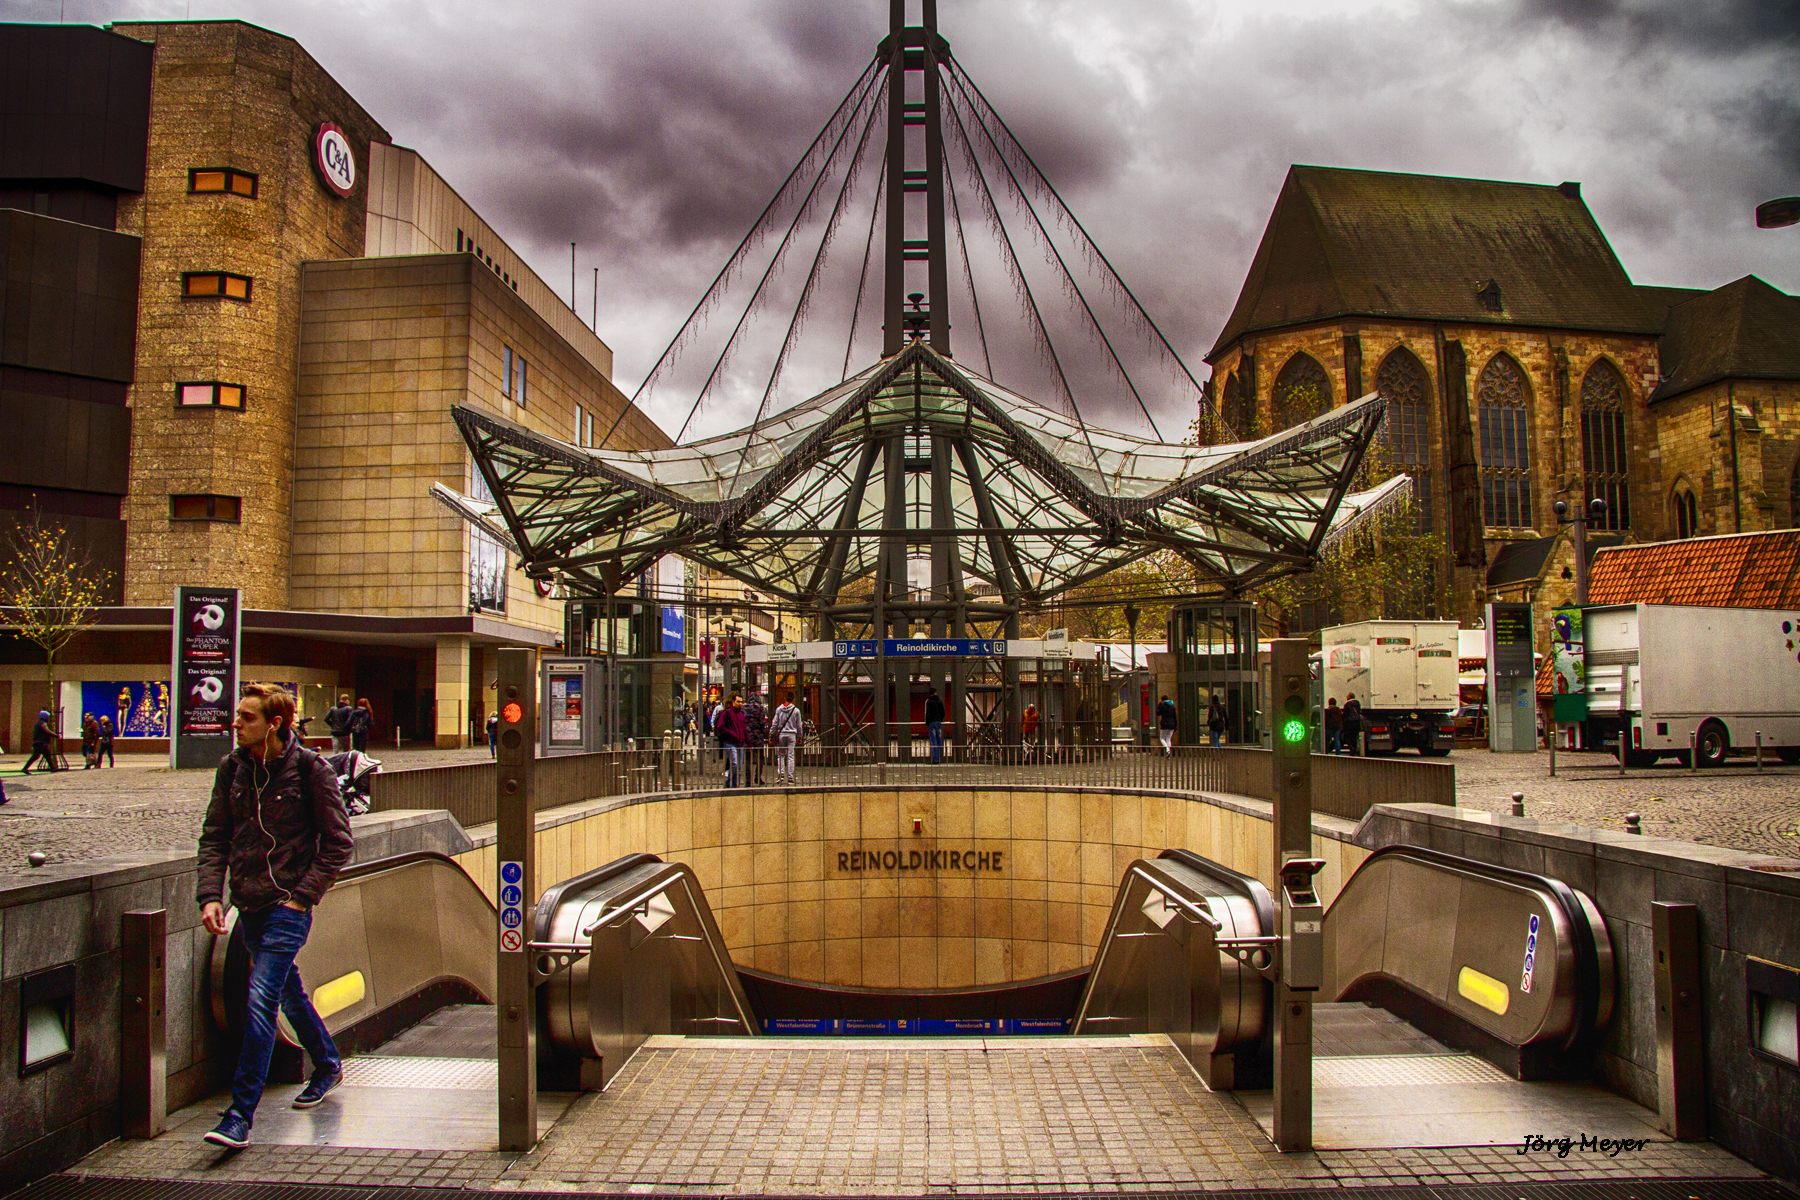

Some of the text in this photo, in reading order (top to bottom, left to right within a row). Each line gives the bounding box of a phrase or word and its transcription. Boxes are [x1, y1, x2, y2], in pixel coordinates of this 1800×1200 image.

[325, 138, 351, 184] C&A
[202, 596, 229, 604] Original!
[194, 637, 229, 645] PHANTOM
[773, 644, 787, 652] Kiosk
[896, 643, 957, 652] Reinoldikirche
[1334, 649, 1358, 666] ARENS
[838, 850, 1003, 871] REINOLDIKIRCHE
